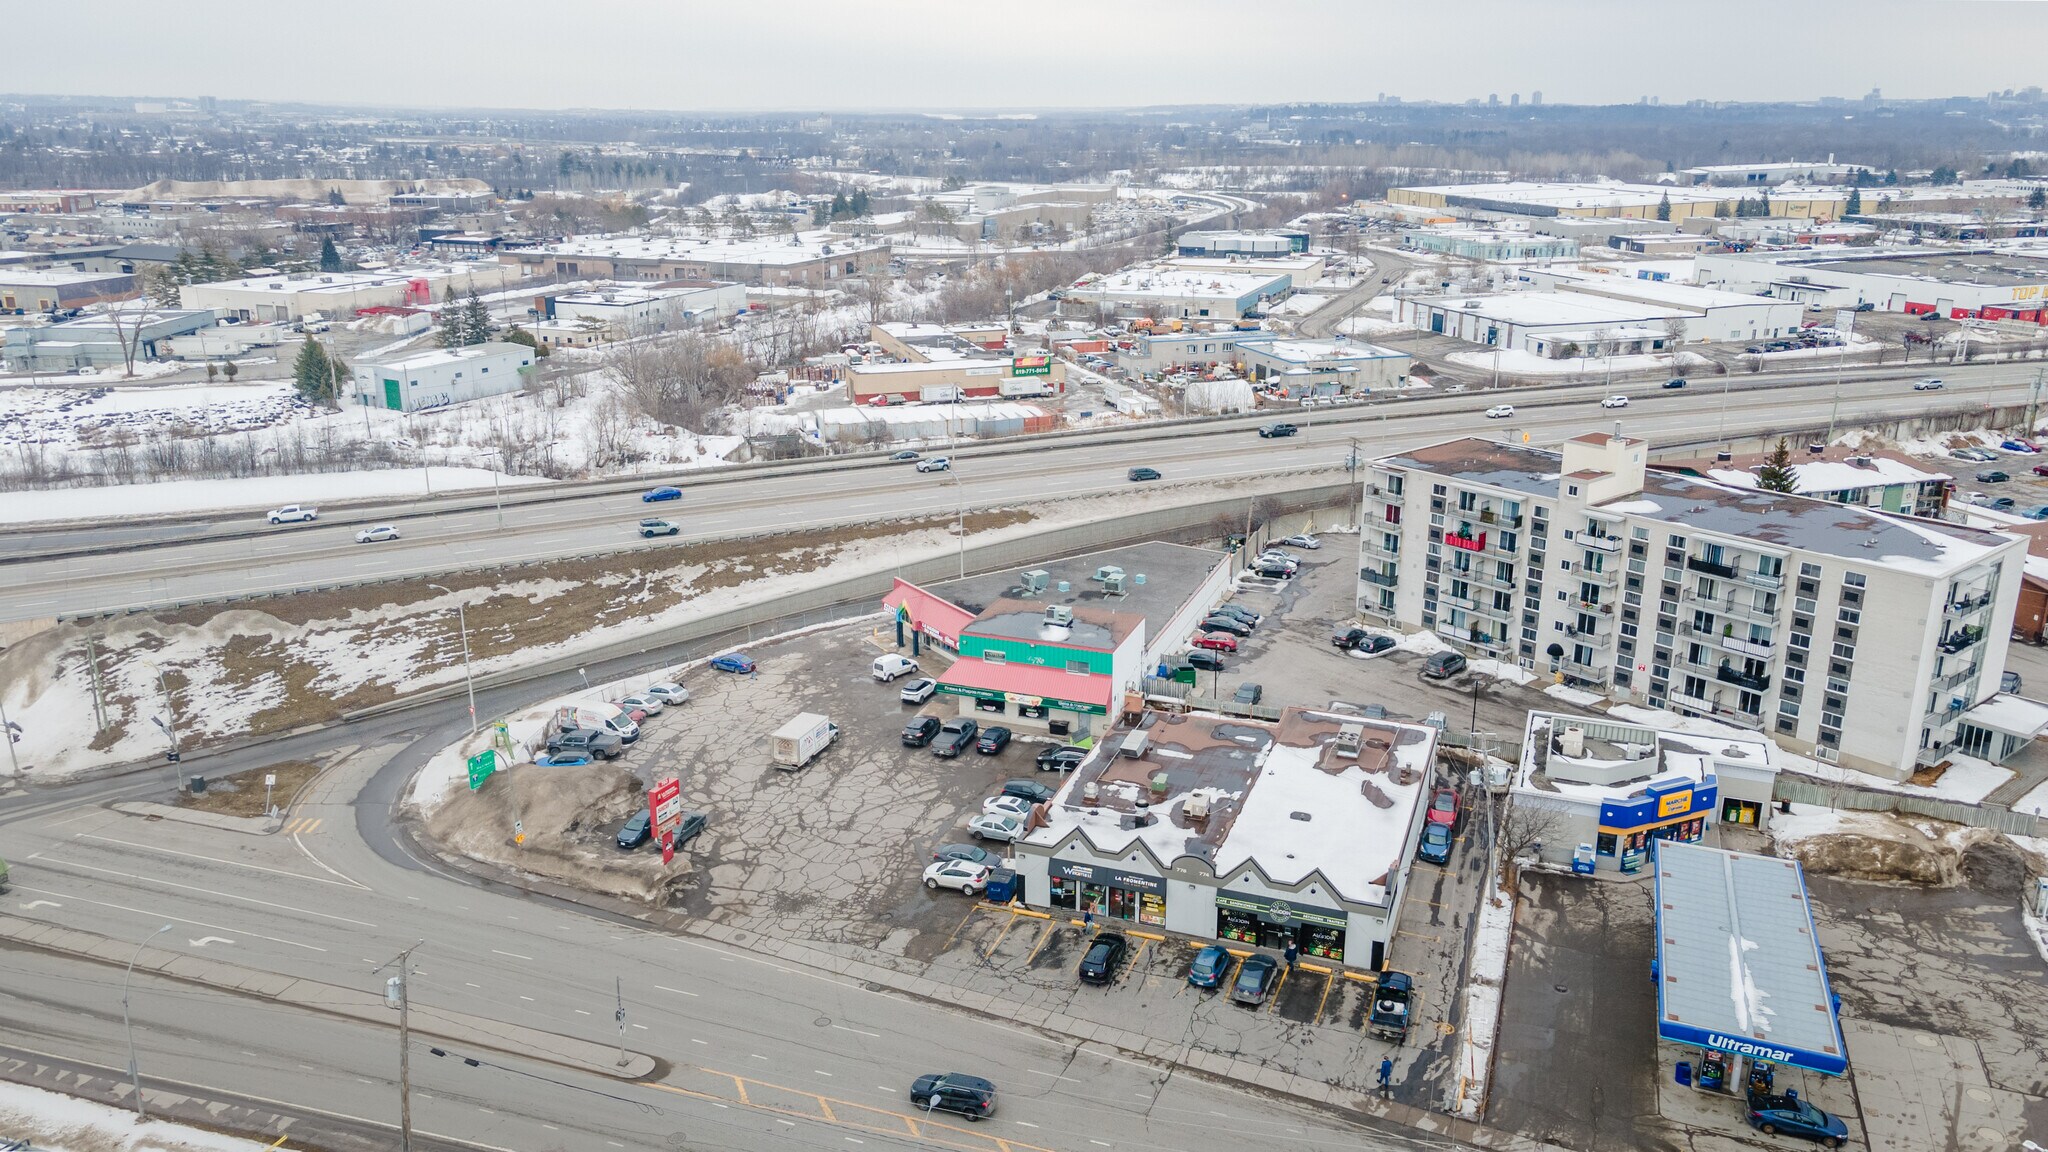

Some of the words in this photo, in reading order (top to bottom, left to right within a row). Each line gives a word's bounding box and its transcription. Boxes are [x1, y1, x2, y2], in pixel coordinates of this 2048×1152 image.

[2012, 286, 2039, 300] TOP
[1666, 796, 1688, 805] MARCHÉ
[1708, 1033, 1794, 1062] Ultramar
